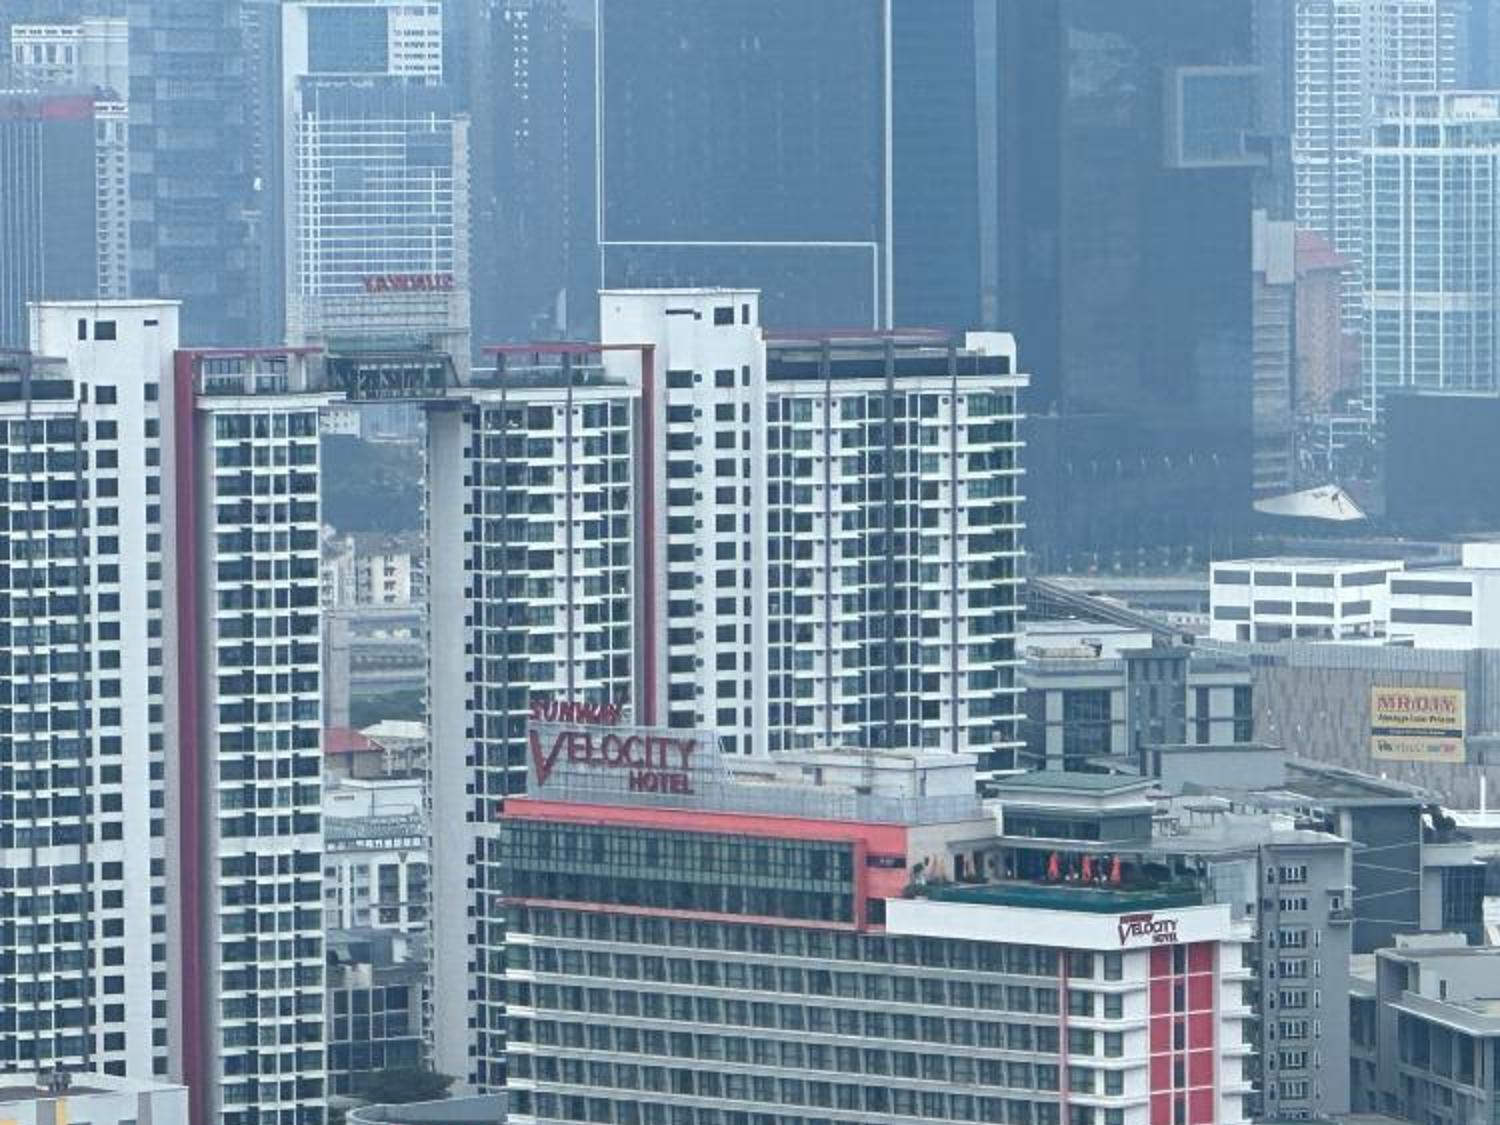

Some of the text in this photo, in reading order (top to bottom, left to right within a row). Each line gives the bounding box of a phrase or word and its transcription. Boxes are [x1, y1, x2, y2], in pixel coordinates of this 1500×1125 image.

[529, 699, 628, 725] SUNWAY
[529, 729, 696, 786] VELOCITY
[629, 769, 694, 794] HOTEL
[1118, 919, 1178, 945] VELOCITY
